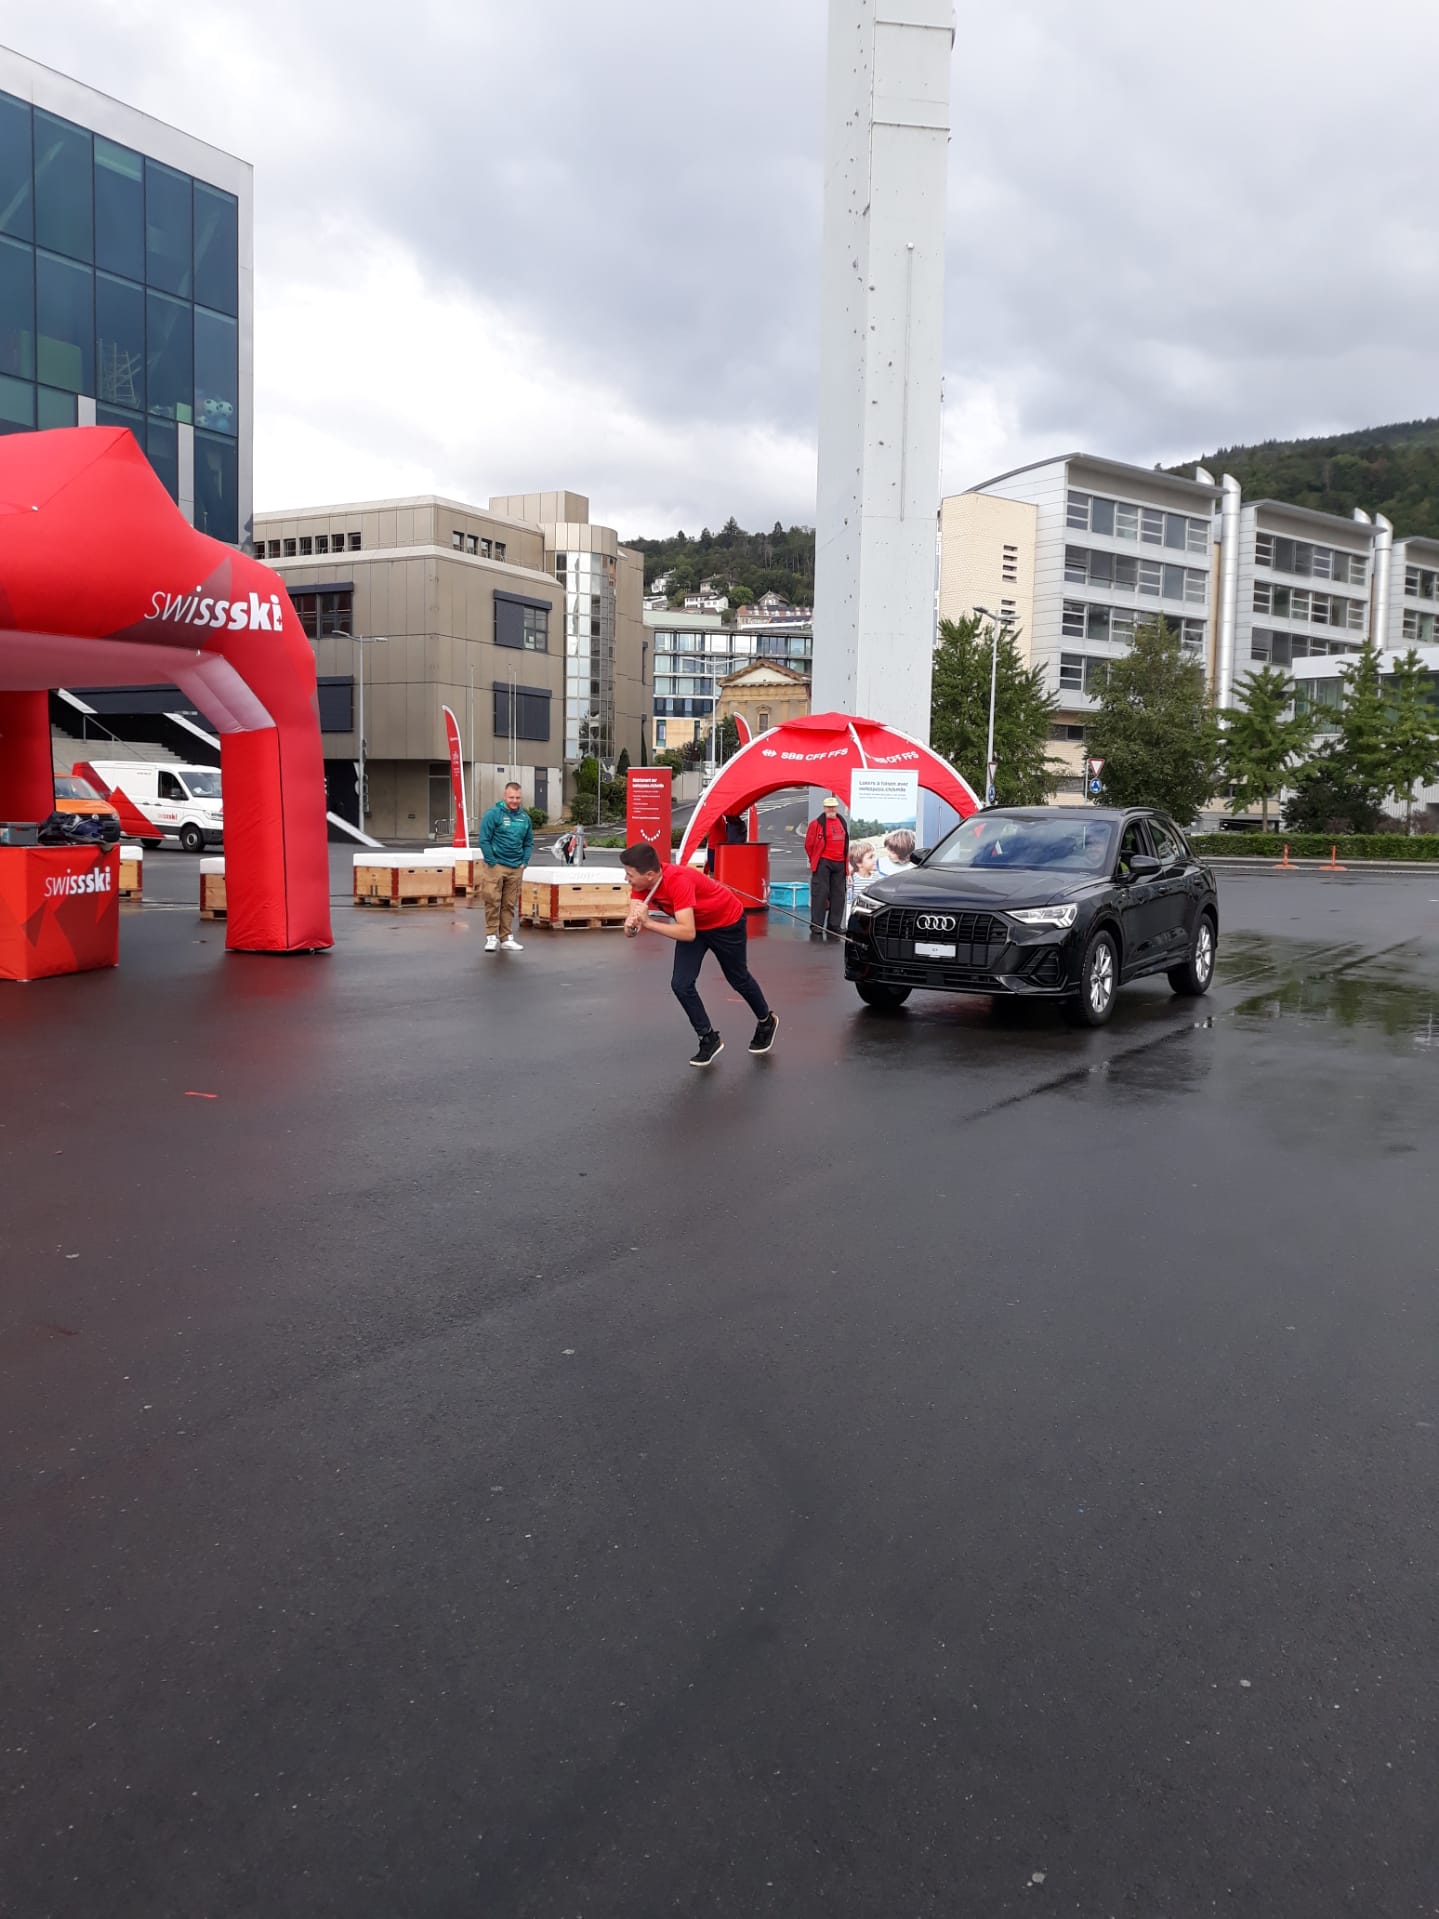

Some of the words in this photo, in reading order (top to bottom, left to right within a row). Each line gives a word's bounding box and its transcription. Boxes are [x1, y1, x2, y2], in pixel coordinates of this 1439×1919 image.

[144, 585, 283, 632] swissski
[781, 751, 804, 761] SBB
[805, 752, 828, 761] CFF
[827, 747, 849, 759] FFS
[901, 751, 920, 761] FFS
[45, 867, 111, 897] swissski
